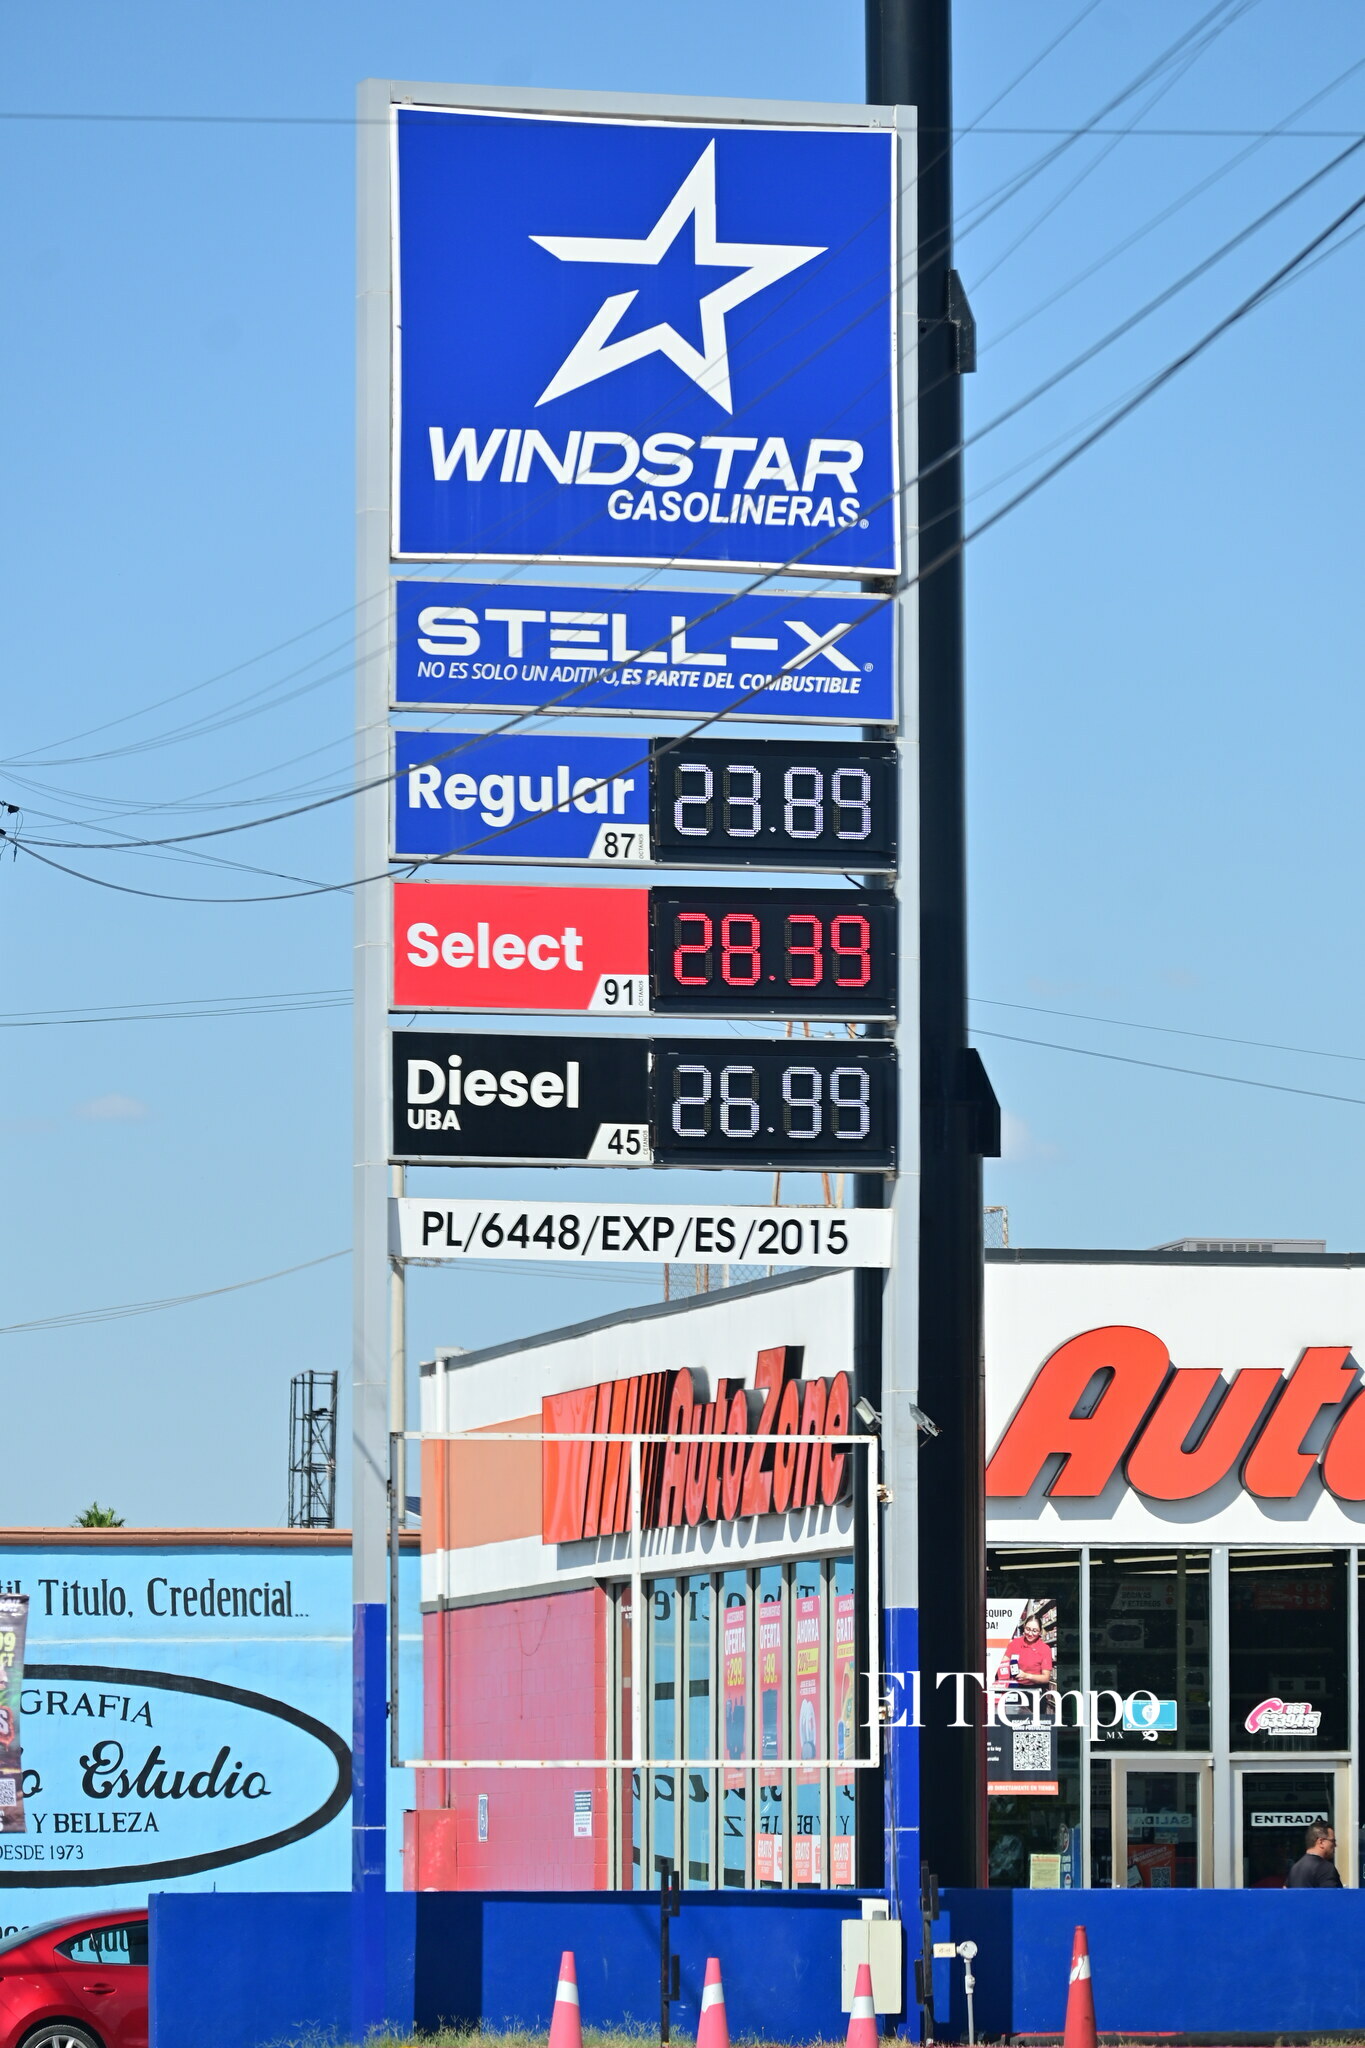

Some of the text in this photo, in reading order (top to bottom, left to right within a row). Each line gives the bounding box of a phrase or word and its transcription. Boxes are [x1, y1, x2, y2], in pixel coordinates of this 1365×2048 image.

[429, 426, 864, 493] WINDSTAR
[607, 489, 860, 528] GASOLINERAS
[416, 605, 861, 673] STELL-X
[417, 661, 445, 679] NO
[448, 662, 470, 681] ES
[472, 663, 519, 682] SOLO
[521, 665, 546, 682] UN
[621, 668, 643, 686] ES
[645, 669, 699, 689] PARTE
[703, 671, 735, 690] DEL
[739, 673, 861, 695] COMBUSTIBLE
[408, 762, 872, 841] Regular 23.89
[604, 831, 635, 859] 87
[406, 912, 871, 988] Select 28.39
[604, 978, 634, 1006] 91
[407, 1054, 871, 1140] Diesel 26.99
[407, 1109, 461, 1132] UBA
[608, 1128, 641, 1156] 45
[422, 1210, 849, 1260] PL/6448/EXP/ES/2015
[986, 1326, 1365, 1502] Aut
[658, 1345, 854, 1528] AutoZone
[725, 1627, 746, 1655] OFERTA
[760, 1622, 780, 1650] OFERTA
[797, 1618, 819, 1644] AHORRA
[836, 1615, 855, 1644] GRATI
[79, 1739, 272, 1800] Estudio
[32, 1811, 160, 1834] Y BELLEZA
[1254, 1814, 1324, 1824] ENTRADA
[50, 1844, 84, 1860] 1973
